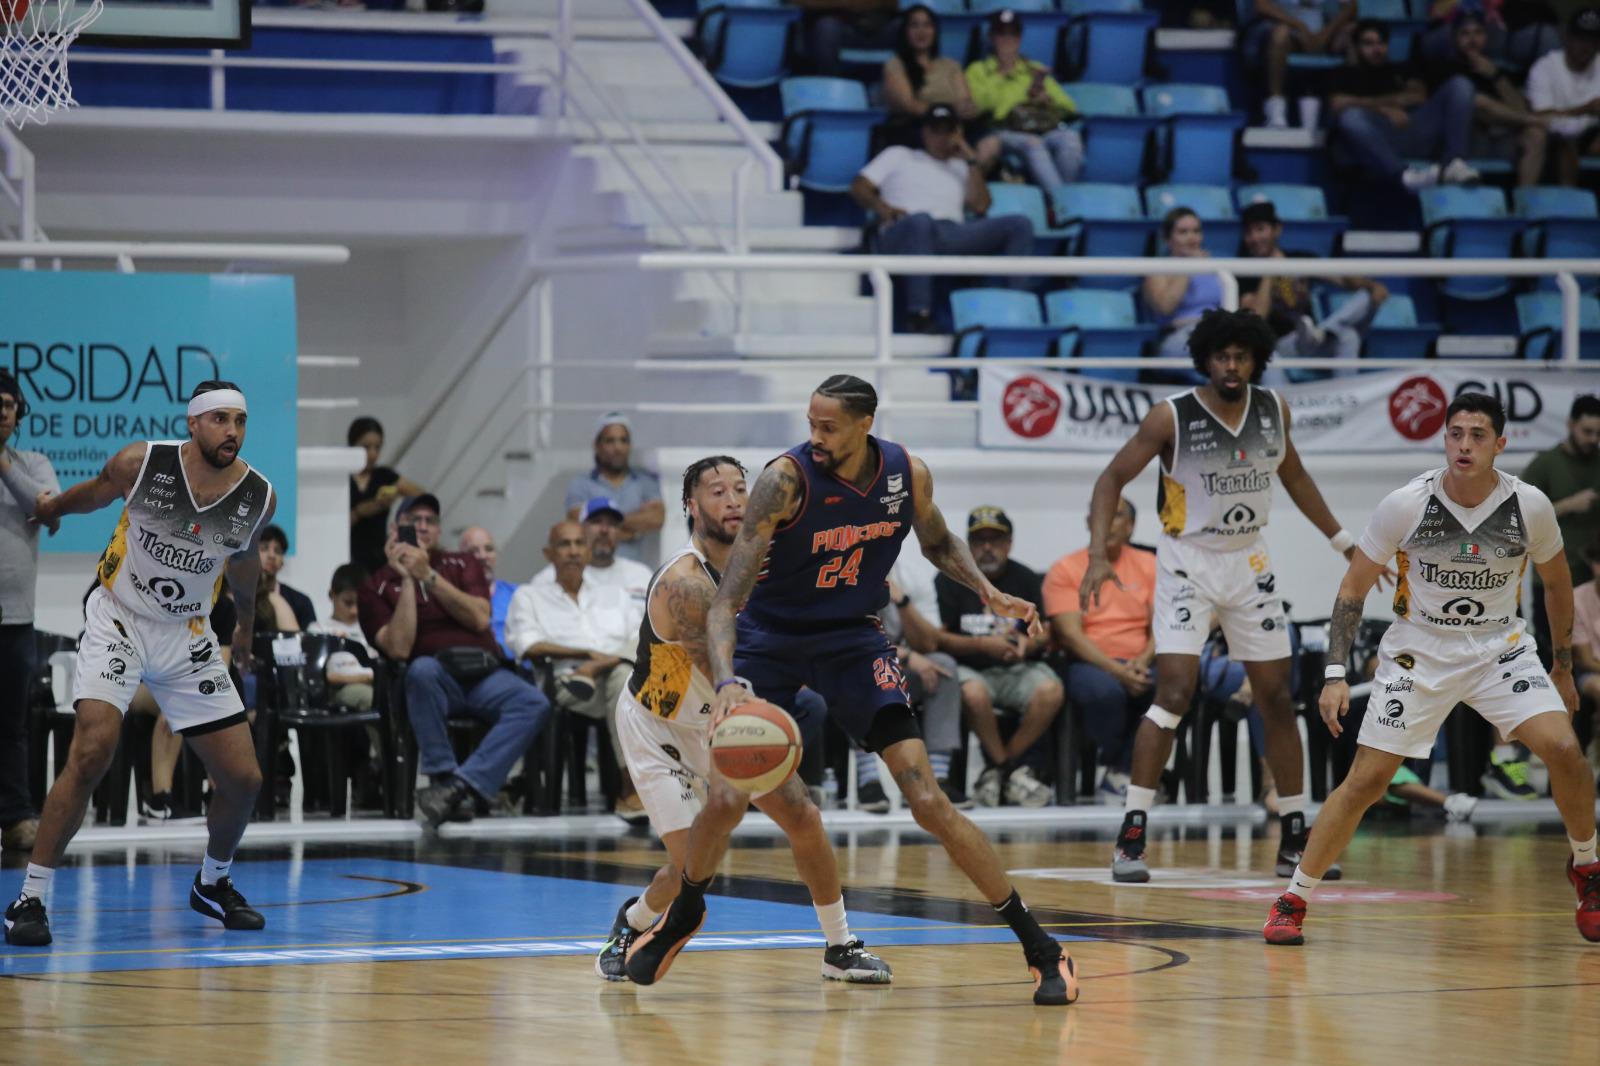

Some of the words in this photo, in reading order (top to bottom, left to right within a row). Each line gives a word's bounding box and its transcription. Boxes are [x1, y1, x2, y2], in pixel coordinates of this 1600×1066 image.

[30, 413, 63, 438] DE
[1420, 516, 1444, 527] elcel
[815, 547, 864, 588] 24
[1376, 715, 1407, 731] MEGA
[202, 934, 827, 963] POERADE
